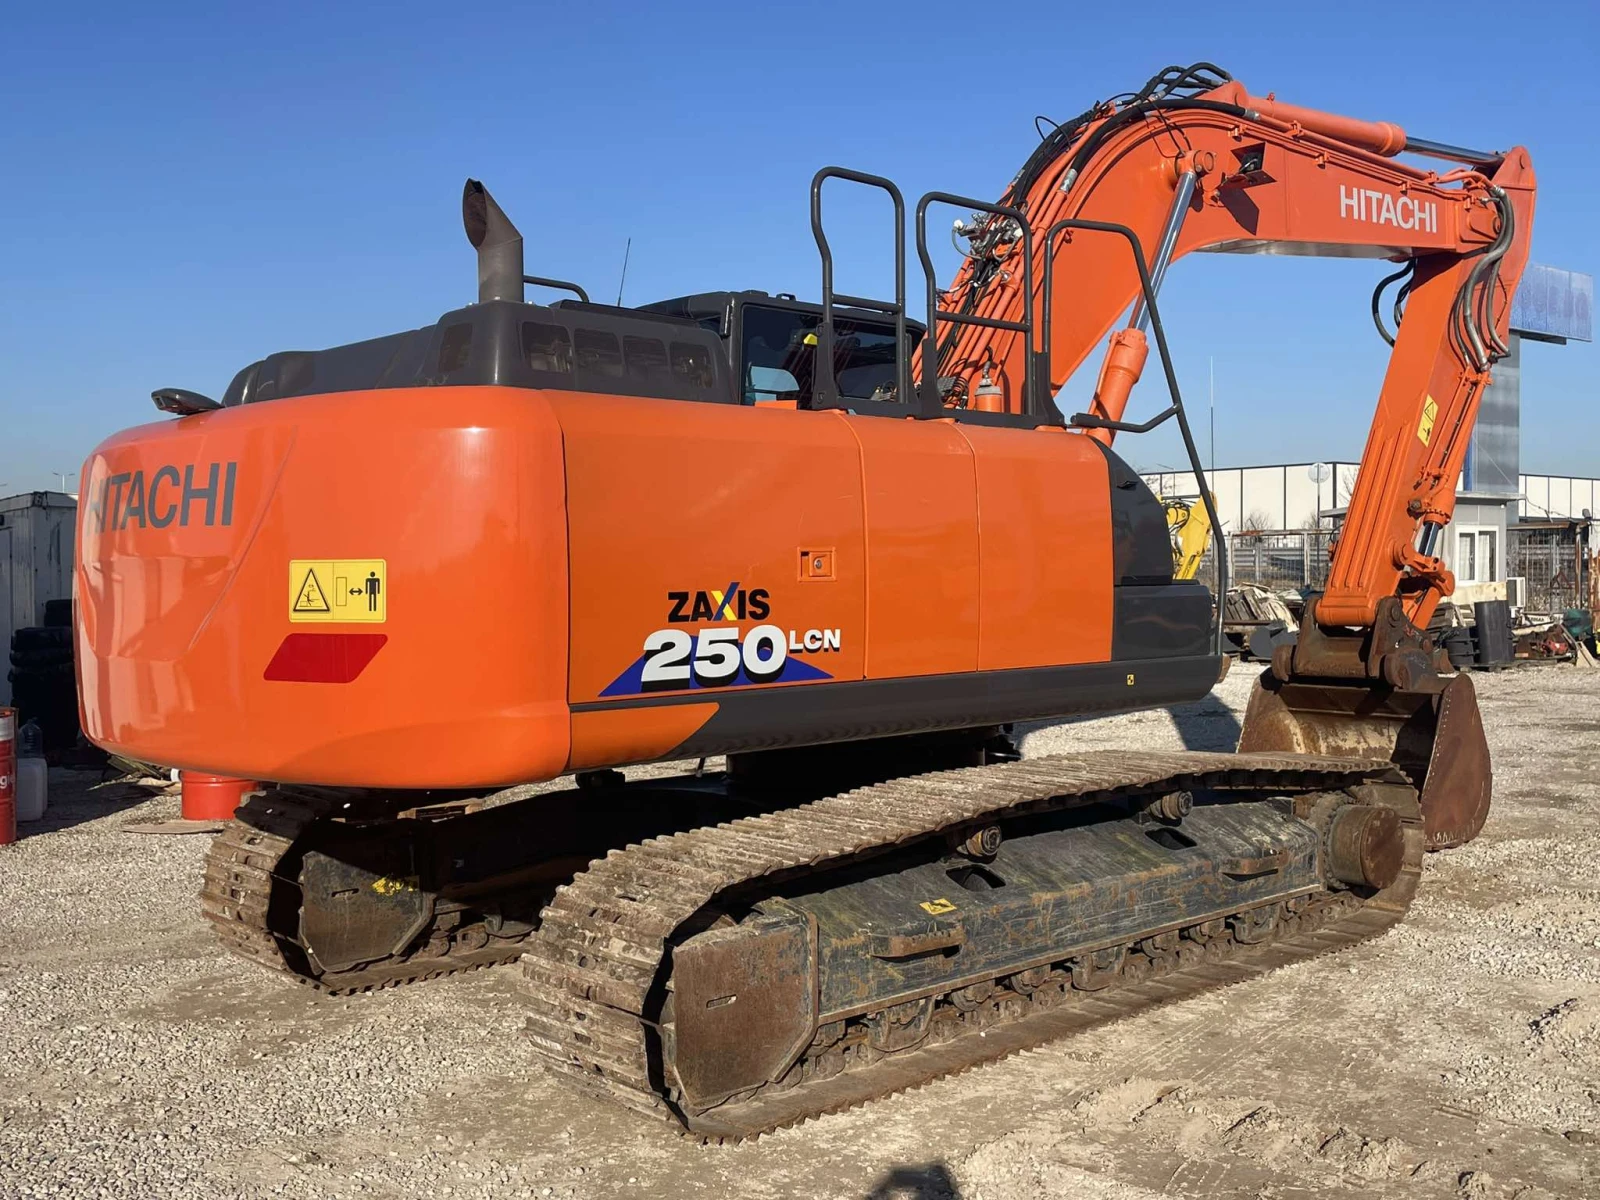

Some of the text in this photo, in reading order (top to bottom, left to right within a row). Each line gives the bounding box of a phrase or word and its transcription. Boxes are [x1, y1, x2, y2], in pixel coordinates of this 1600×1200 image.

[1340, 184, 1437, 233] HITACHI
[87, 462, 237, 535] HITACHI
[667, 582, 770, 622] ZAXIS
[640, 624, 841, 692] 250 LCN
